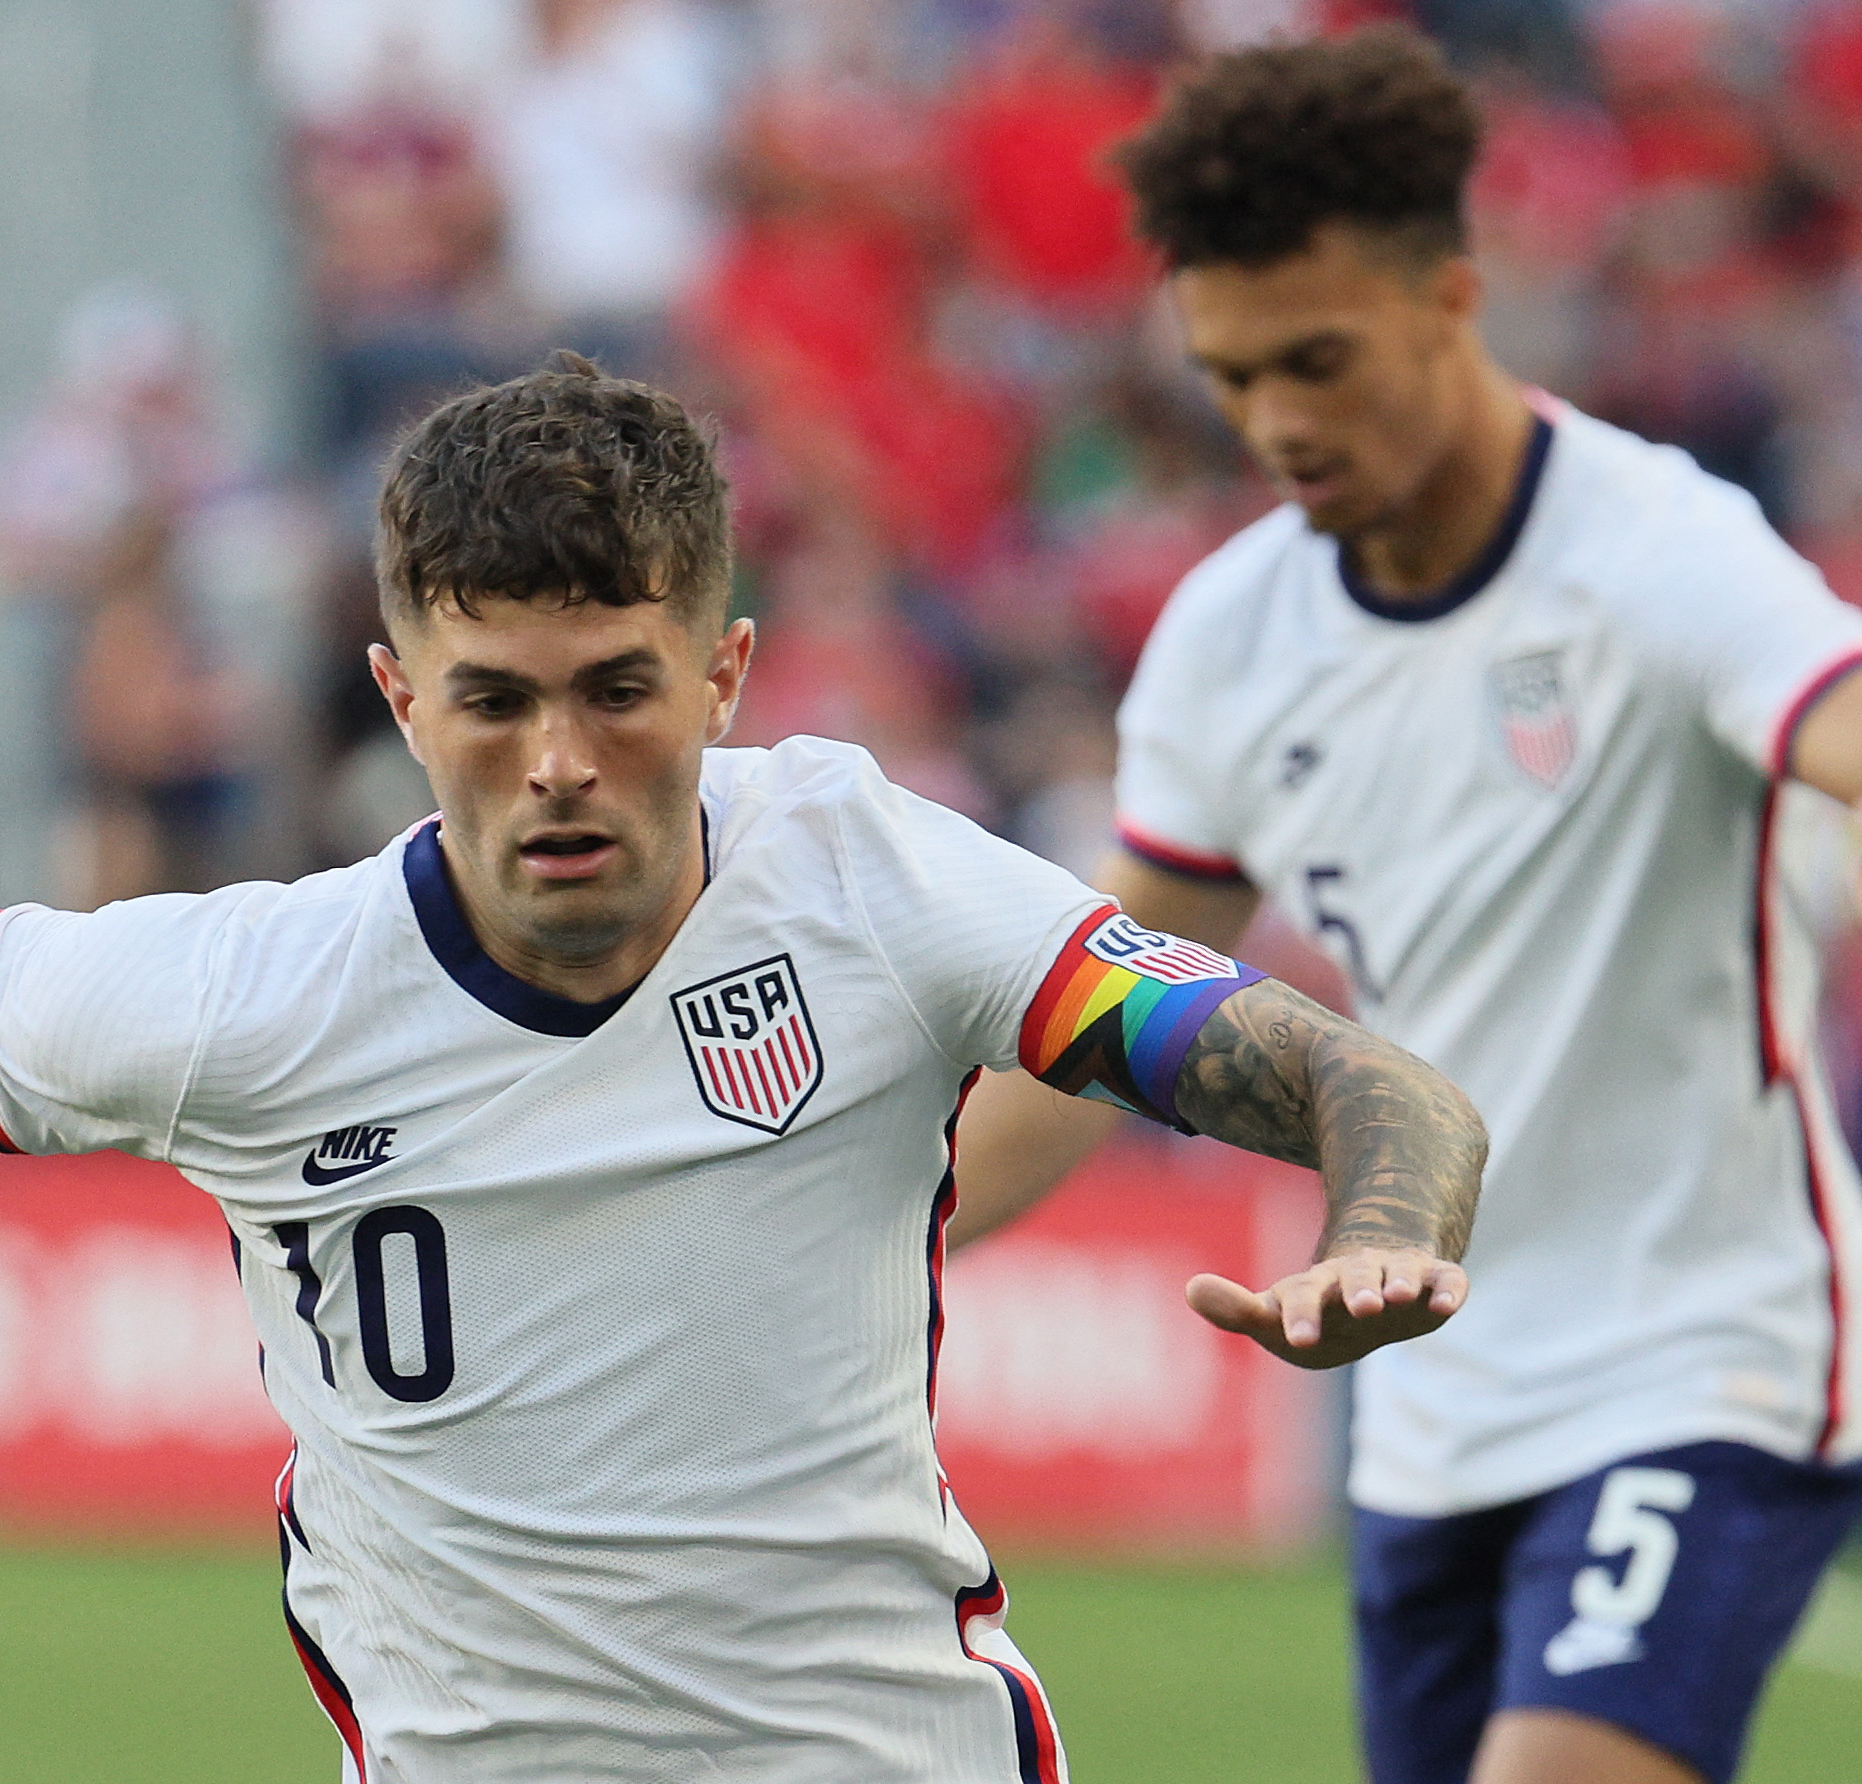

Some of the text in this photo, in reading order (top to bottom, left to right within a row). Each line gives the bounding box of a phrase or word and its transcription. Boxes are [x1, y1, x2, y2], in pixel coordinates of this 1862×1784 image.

[1095, 918, 1168, 958] US
[685, 970, 790, 1041] USA
[317, 1125, 398, 1161] NIKE
[271, 1203, 457, 1404] 10
[1568, 1465, 1698, 1629] 5
